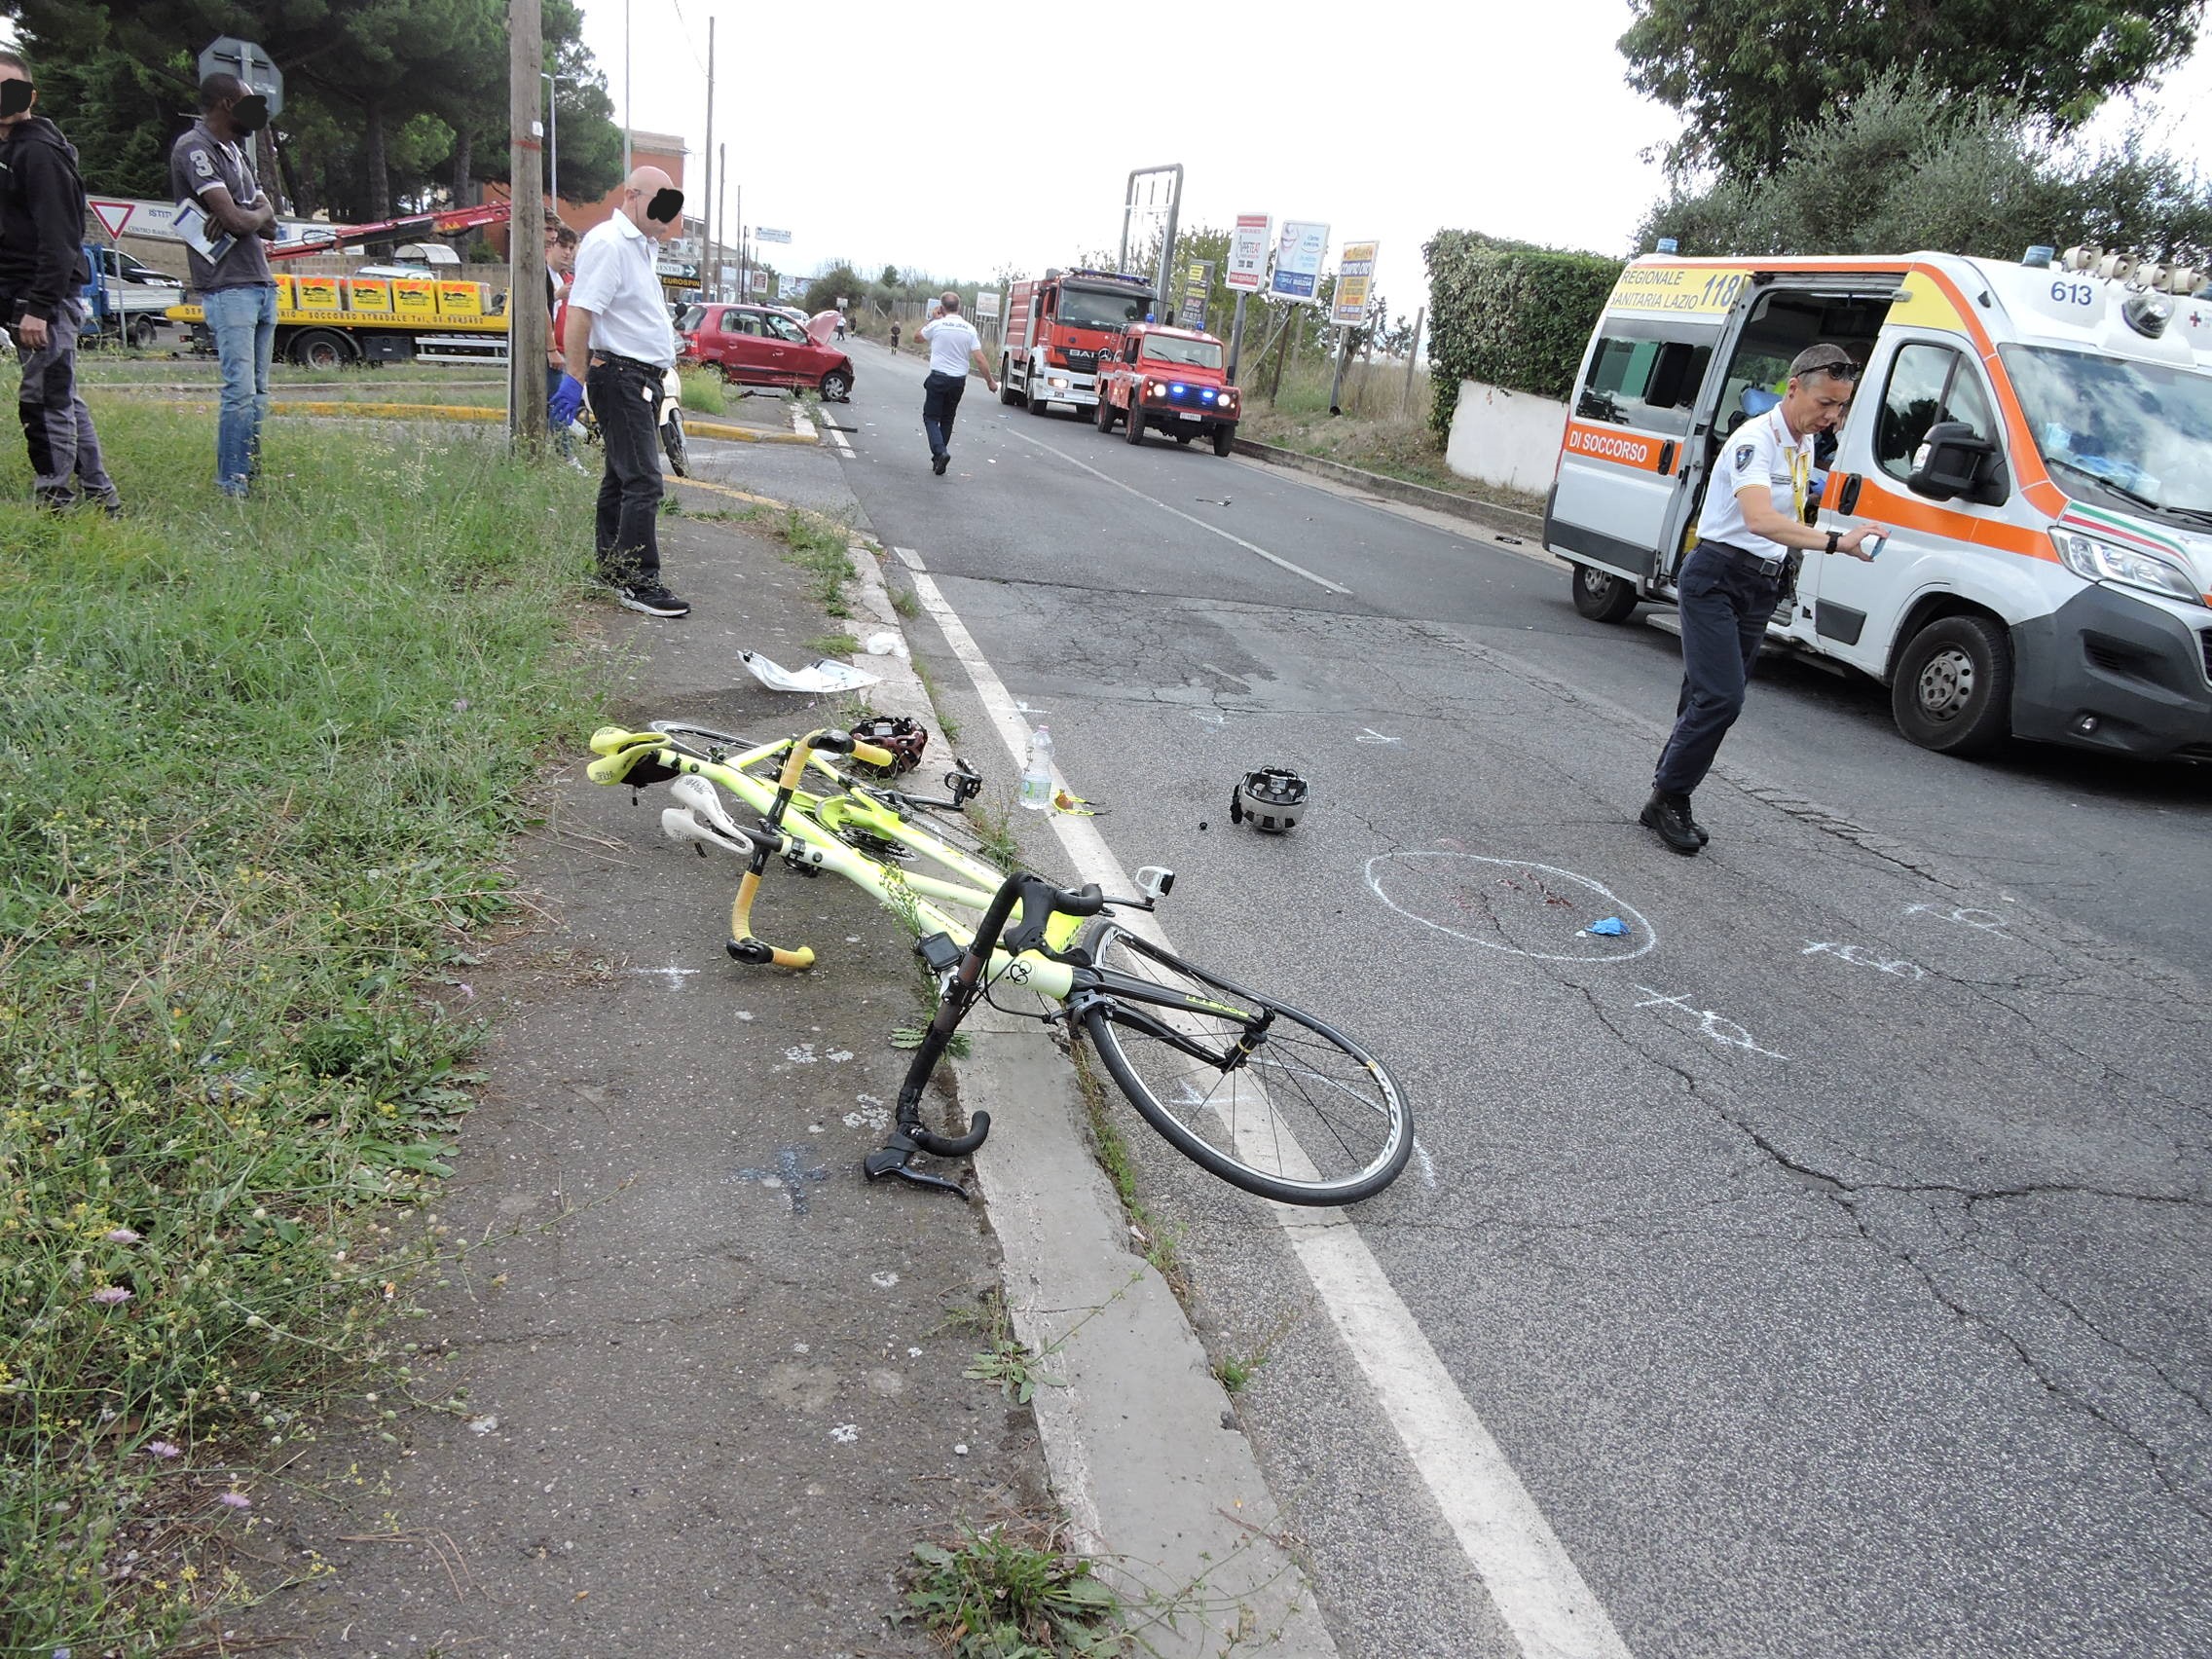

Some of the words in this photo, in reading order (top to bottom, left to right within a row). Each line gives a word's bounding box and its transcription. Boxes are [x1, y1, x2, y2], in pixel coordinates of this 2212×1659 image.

[190, 149, 214, 177] 3
[662, 276, 700, 287] EUROSPIN
[1621, 271, 1684, 286] REGIONALE
[1701, 274, 1741, 308] 118
[2050, 280, 2093, 306] 613
[1663, 294, 1699, 310] LAZIO
[1069, 349, 1095, 359] BAI
[1568, 430, 1582, 449] DI
[1582, 432, 1647, 463] SOCCORSO
